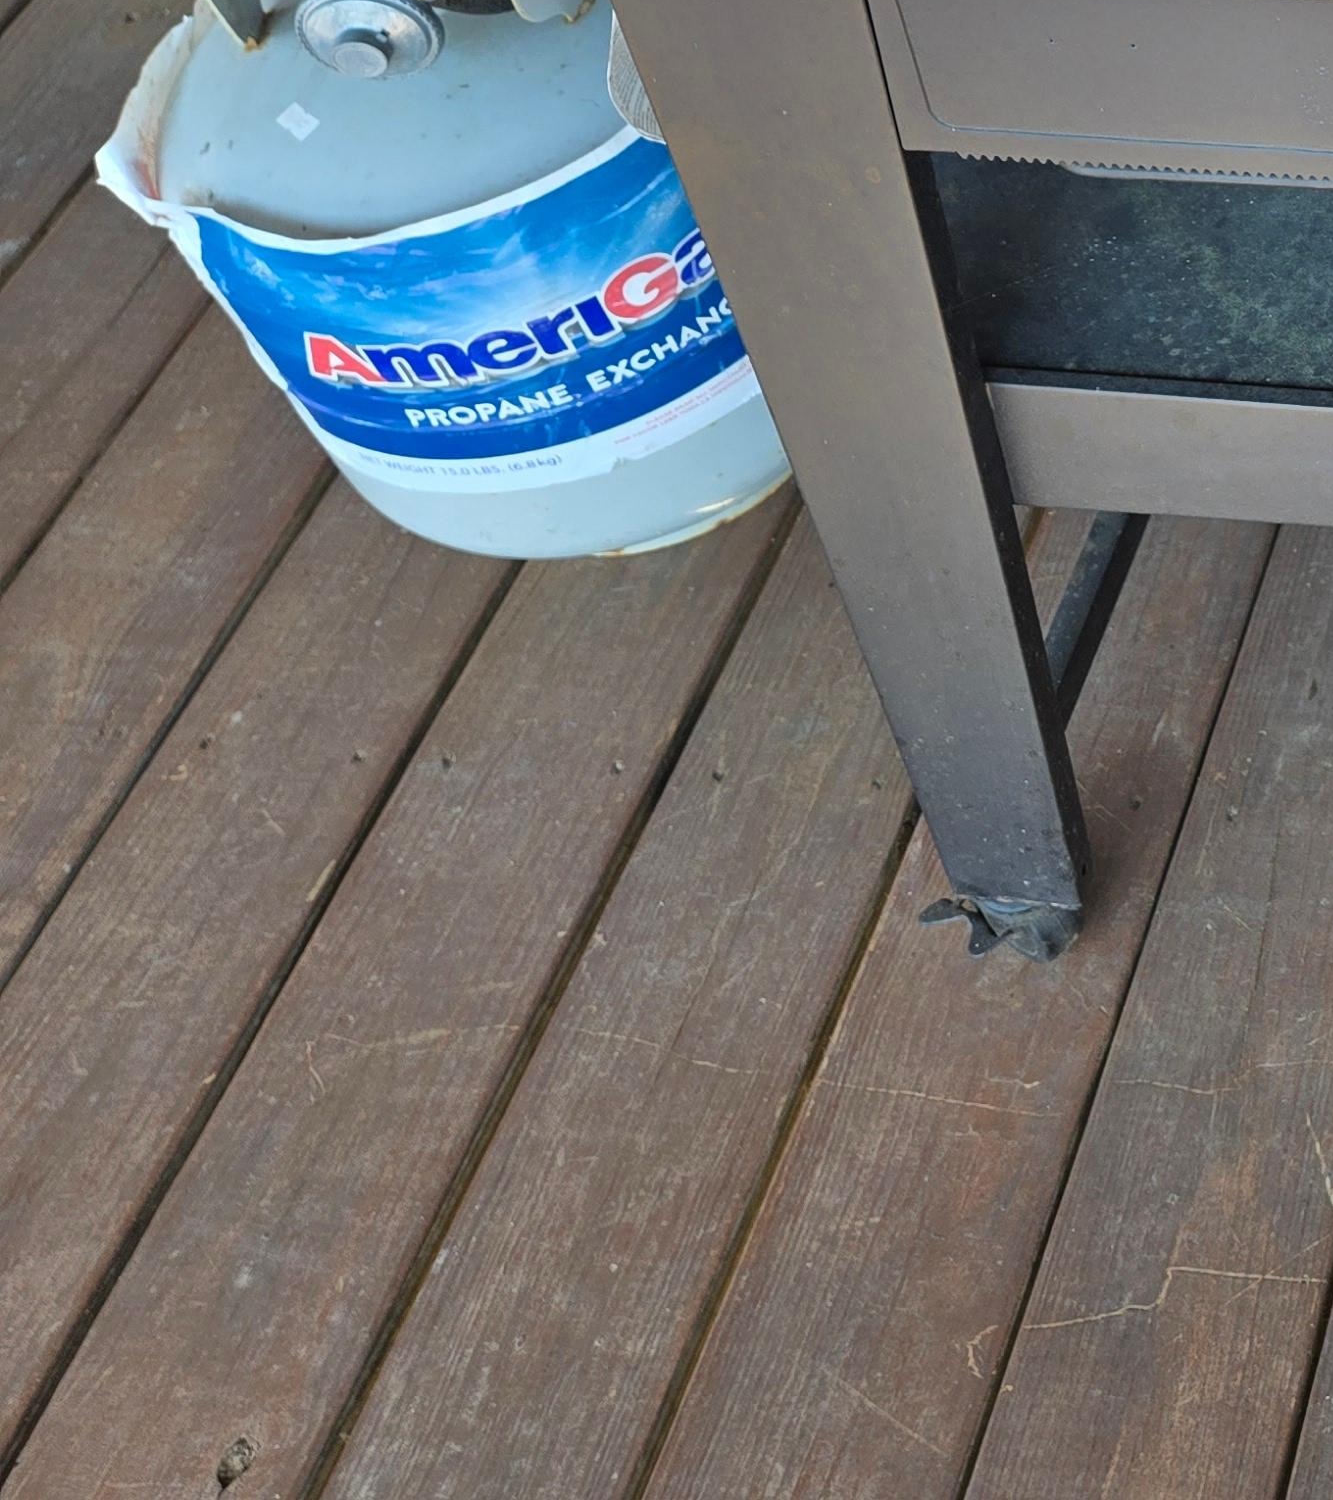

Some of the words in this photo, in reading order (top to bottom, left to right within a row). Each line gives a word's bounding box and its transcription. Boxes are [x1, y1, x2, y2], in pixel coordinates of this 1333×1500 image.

[303, 228, 716, 390] AmeriGa
[404, 383, 574, 428] PROPANE
[585, 297, 731, 393] EXCHAN
[385, 460, 436, 475] WEIGHT
[440, 466, 471, 477] 15.0
